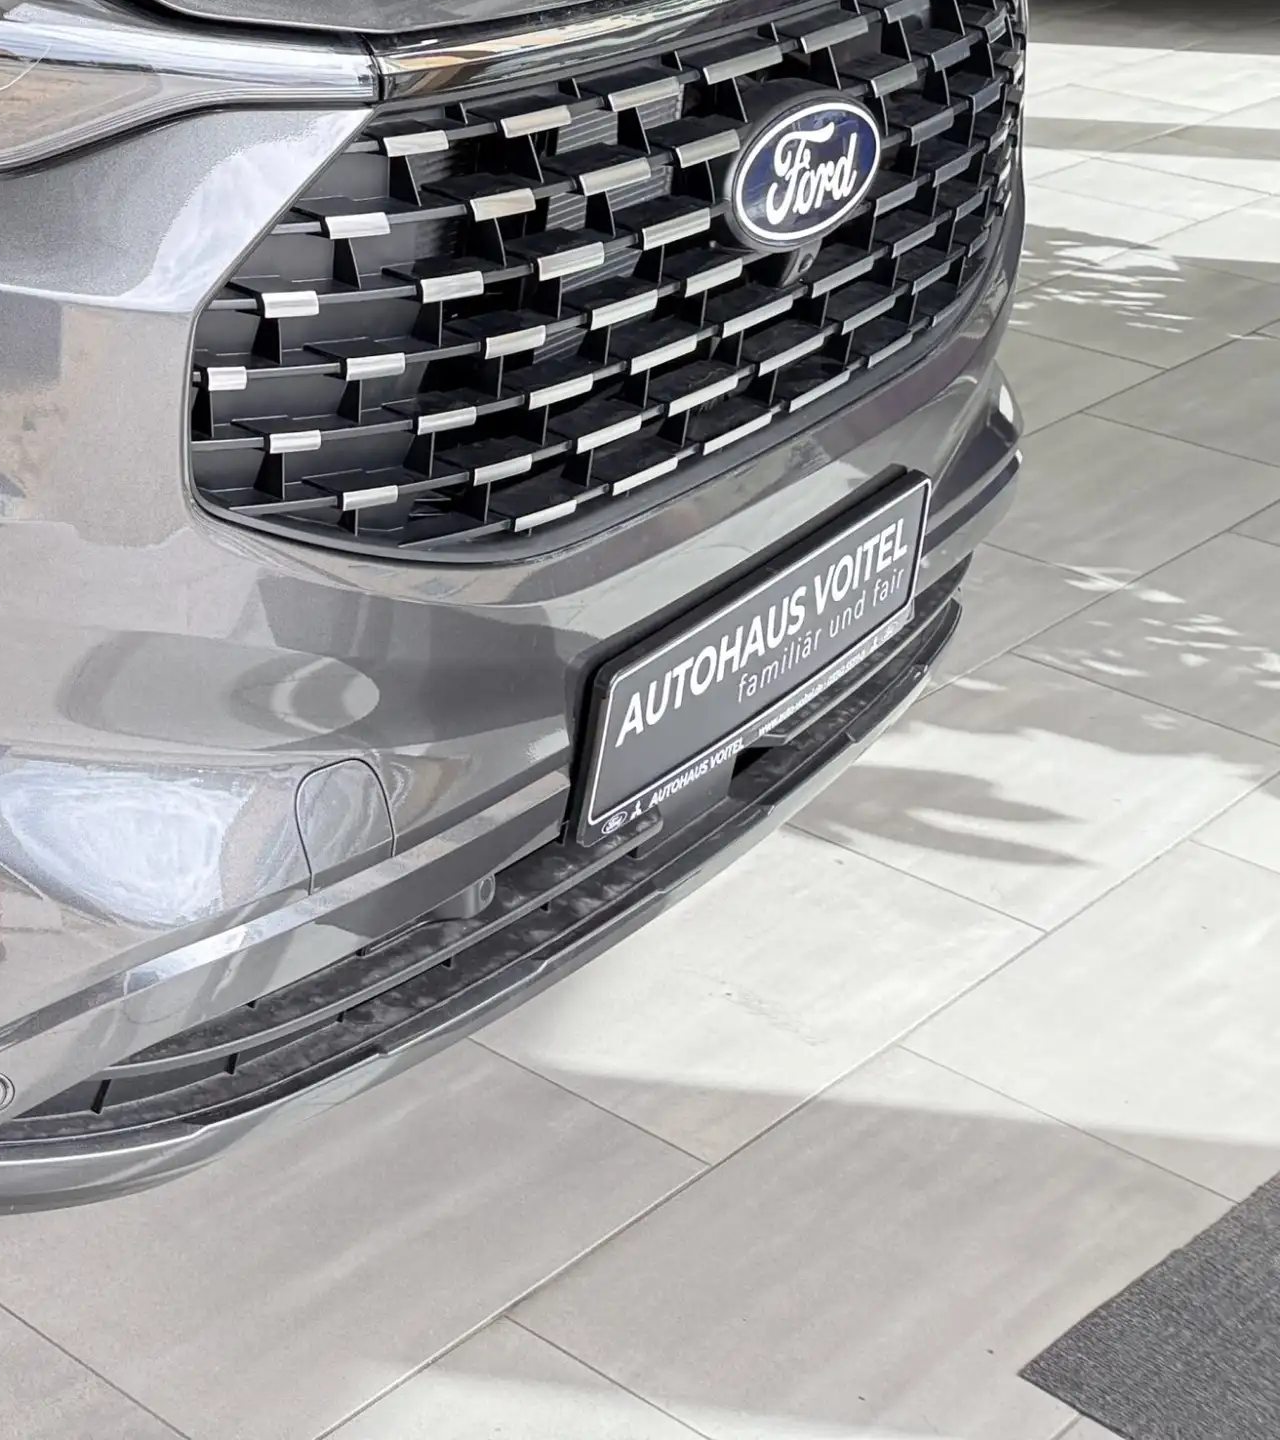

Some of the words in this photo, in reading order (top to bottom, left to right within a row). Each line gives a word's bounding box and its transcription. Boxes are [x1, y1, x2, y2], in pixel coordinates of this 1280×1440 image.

[763, 119, 860, 227] Ford
[614, 583, 807, 748] AUTOHAUS
[813, 516, 908, 616] VOITEL
[736, 628, 822, 704] familiär
[828, 595, 866, 639] und
[871, 567, 905, 611] fair
[647, 758, 710, 808] AUTOHAUS
[709, 737, 745, 769] VOITEL
